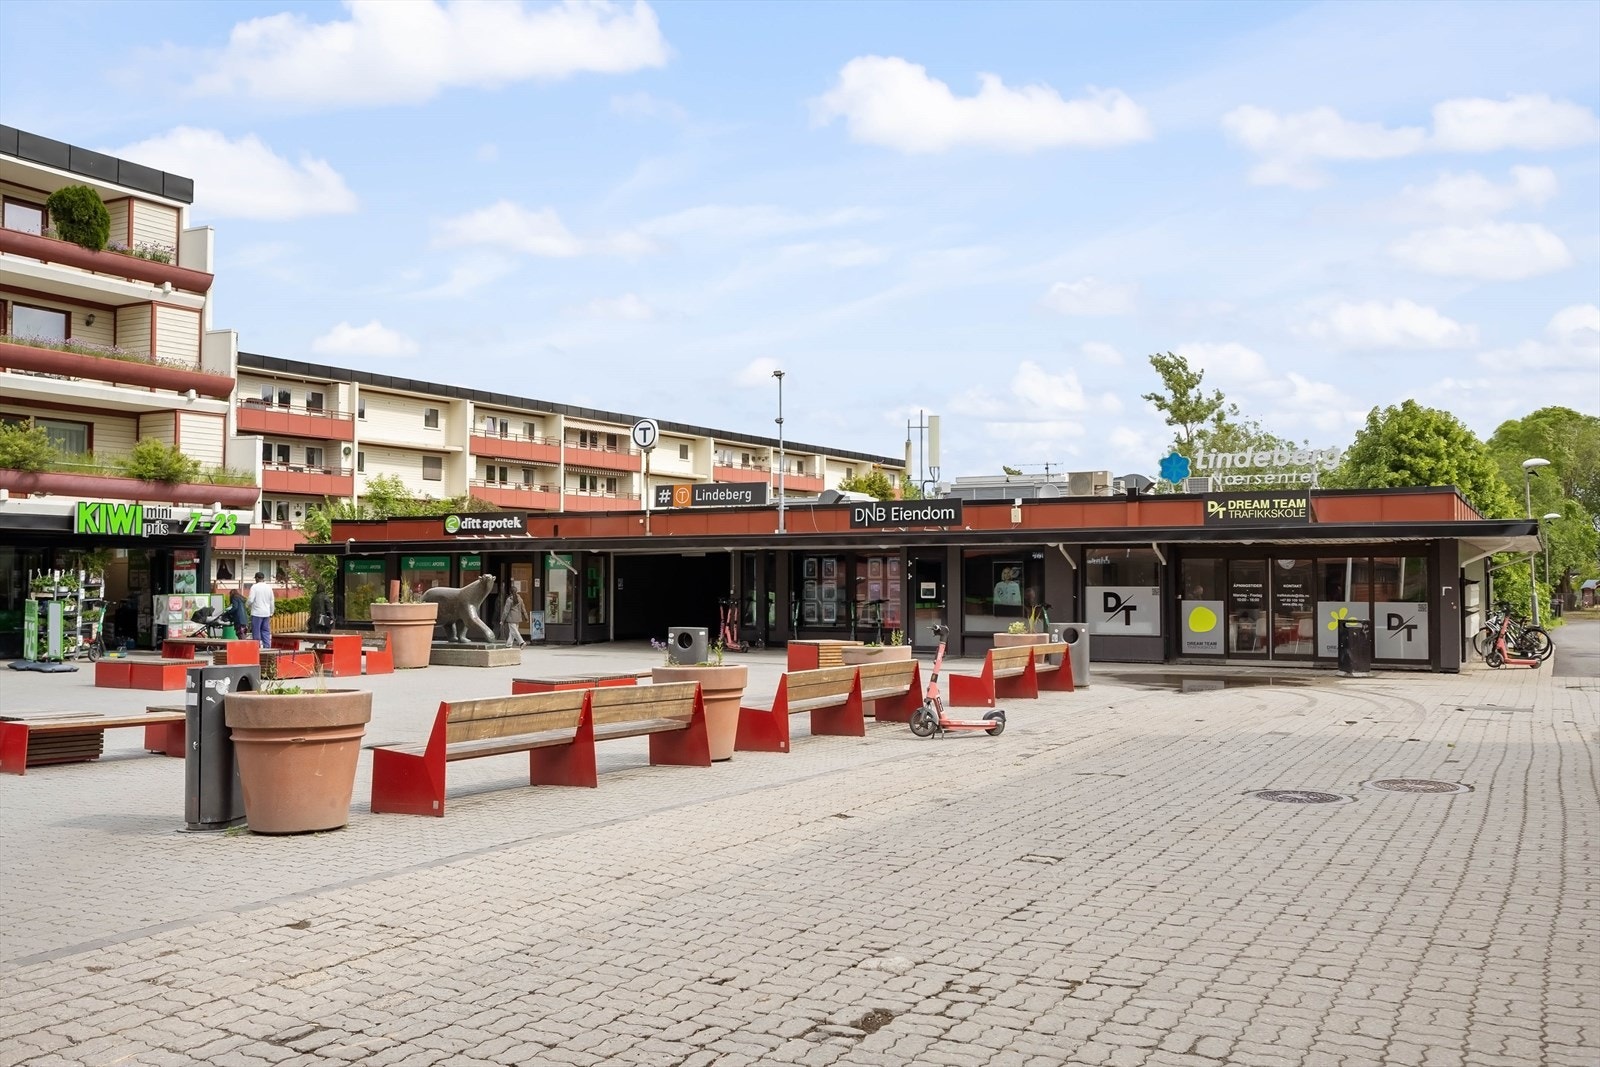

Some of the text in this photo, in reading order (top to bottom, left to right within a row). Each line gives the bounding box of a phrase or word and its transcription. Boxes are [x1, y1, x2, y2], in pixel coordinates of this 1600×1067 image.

[639, 427, 651, 443] T
[695, 489, 752, 502] Lindeberg
[146, 504, 172, 519] mini
[1228, 499, 1306, 509] DREAM TEAM
[77, 501, 143, 535] KIWI
[855, 502, 955, 526] DNB Eiendom
[1228, 508, 1306, 519] TRAFIKKSKOLE
[145, 521, 169, 537] pris
[461, 516, 522, 532] ditt apotek
